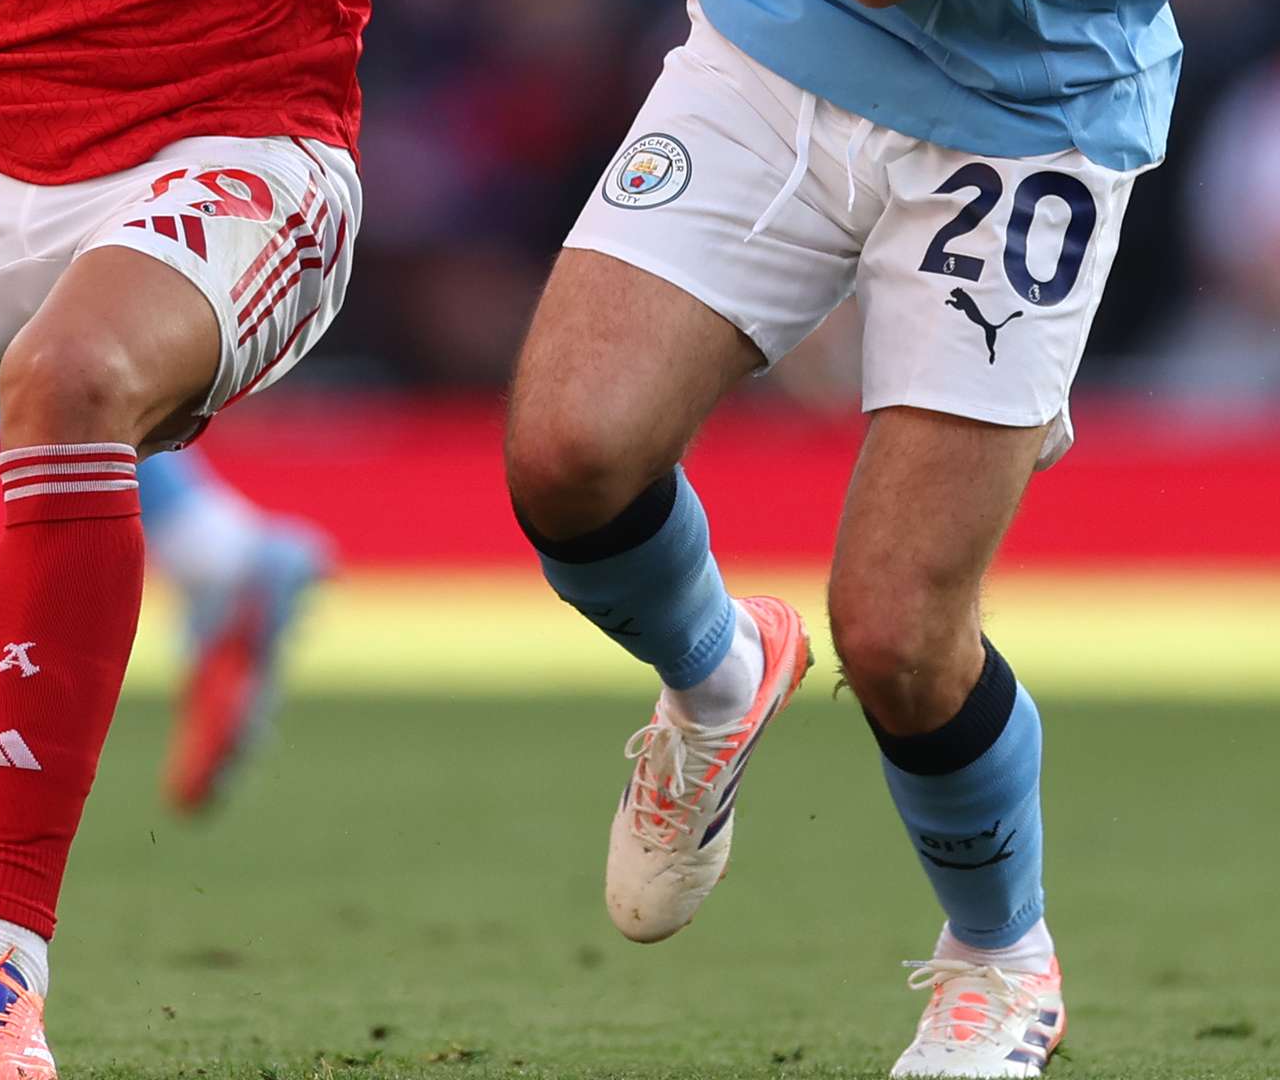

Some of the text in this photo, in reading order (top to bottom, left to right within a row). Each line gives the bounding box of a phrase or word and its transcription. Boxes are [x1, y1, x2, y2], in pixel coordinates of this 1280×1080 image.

[623, 138, 685, 173] MANCHESTER
[615, 193, 640, 205] CITY
[918, 161, 1098, 308] 20
